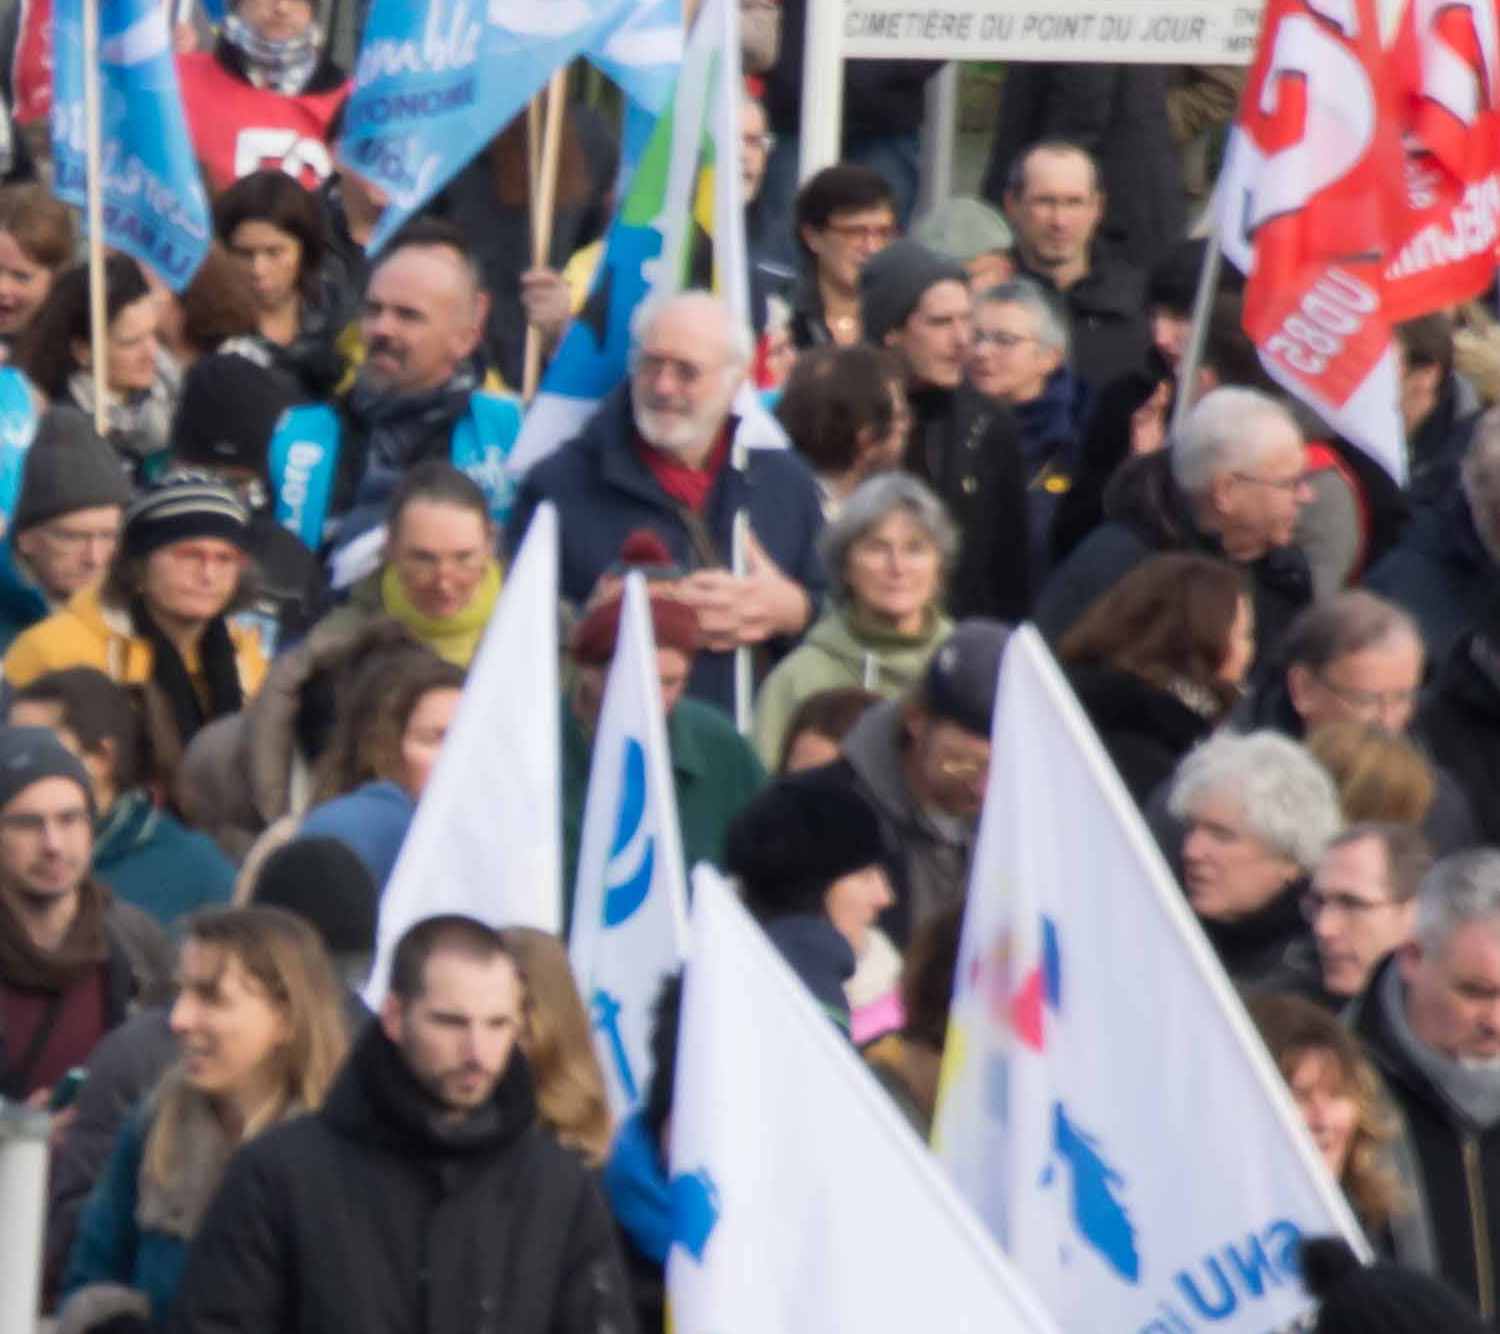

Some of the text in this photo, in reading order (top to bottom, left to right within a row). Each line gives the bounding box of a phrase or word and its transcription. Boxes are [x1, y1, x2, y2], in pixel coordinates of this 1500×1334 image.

[981, 13, 1012, 41] DU
[1023, 13, 1096, 43] POINT
[1100, 15, 1133, 43] DU
[1140, 16, 1208, 45] JOUR
